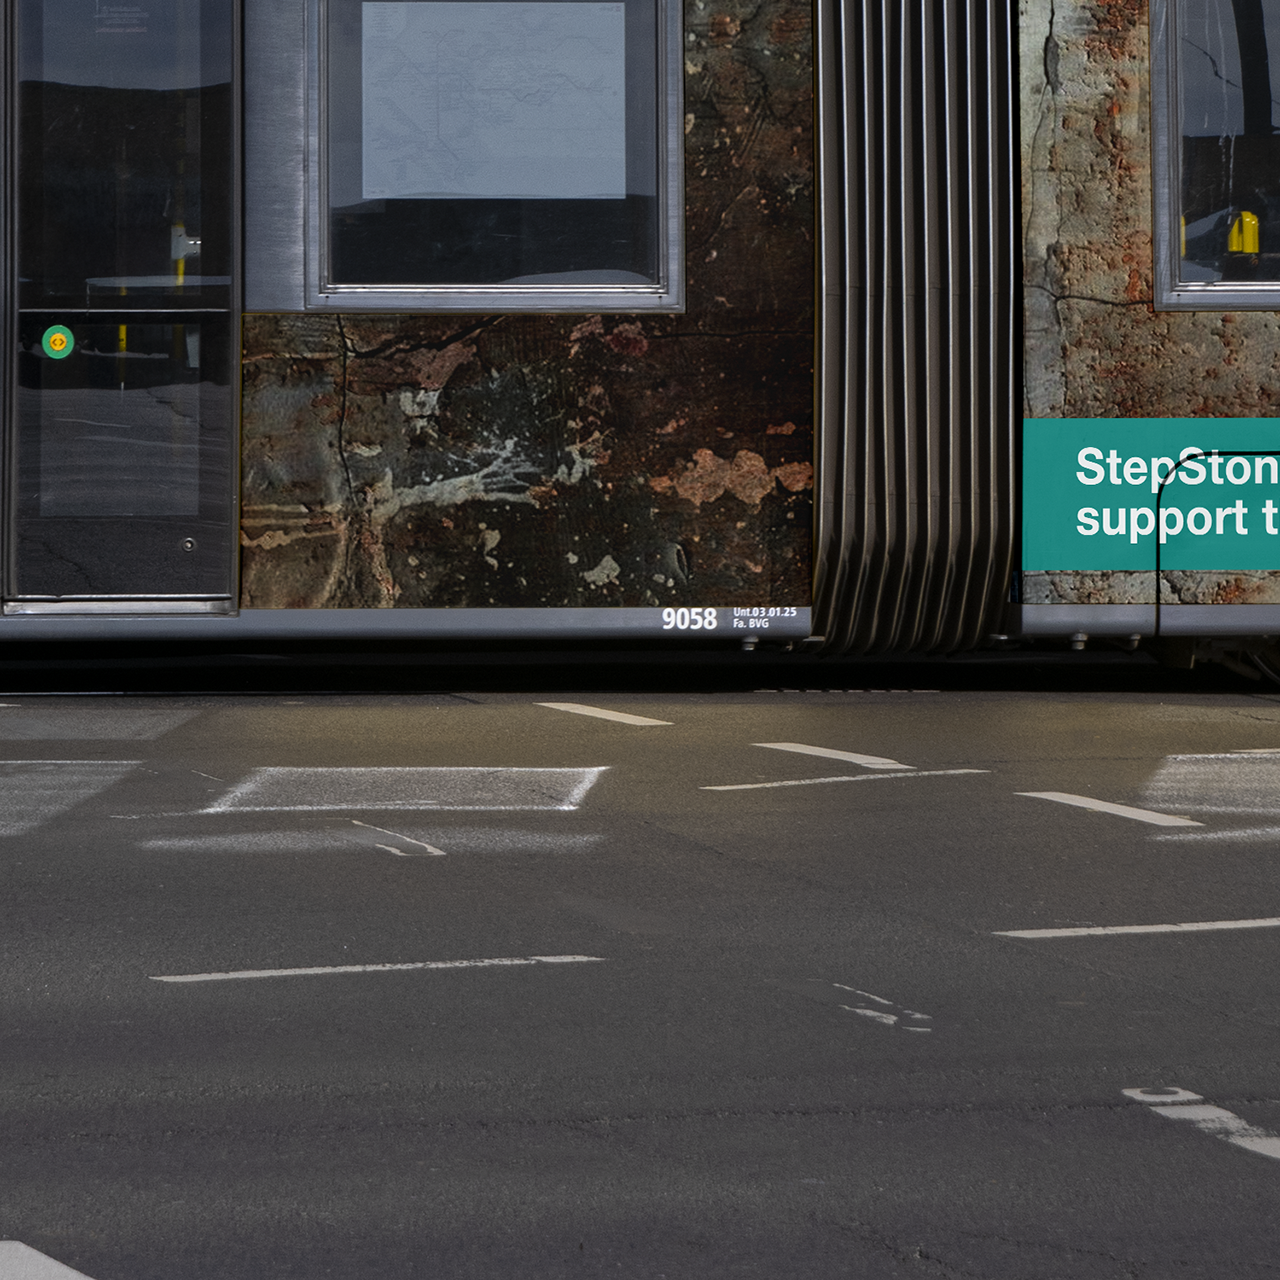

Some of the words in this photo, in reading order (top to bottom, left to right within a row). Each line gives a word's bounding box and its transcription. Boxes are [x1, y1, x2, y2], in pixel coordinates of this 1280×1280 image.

[1076, 498, 1248, 544] support
[662, 607, 718, 630] 9058
[733, 618, 747, 628] Fa.
[749, 618, 770, 629] BVG
